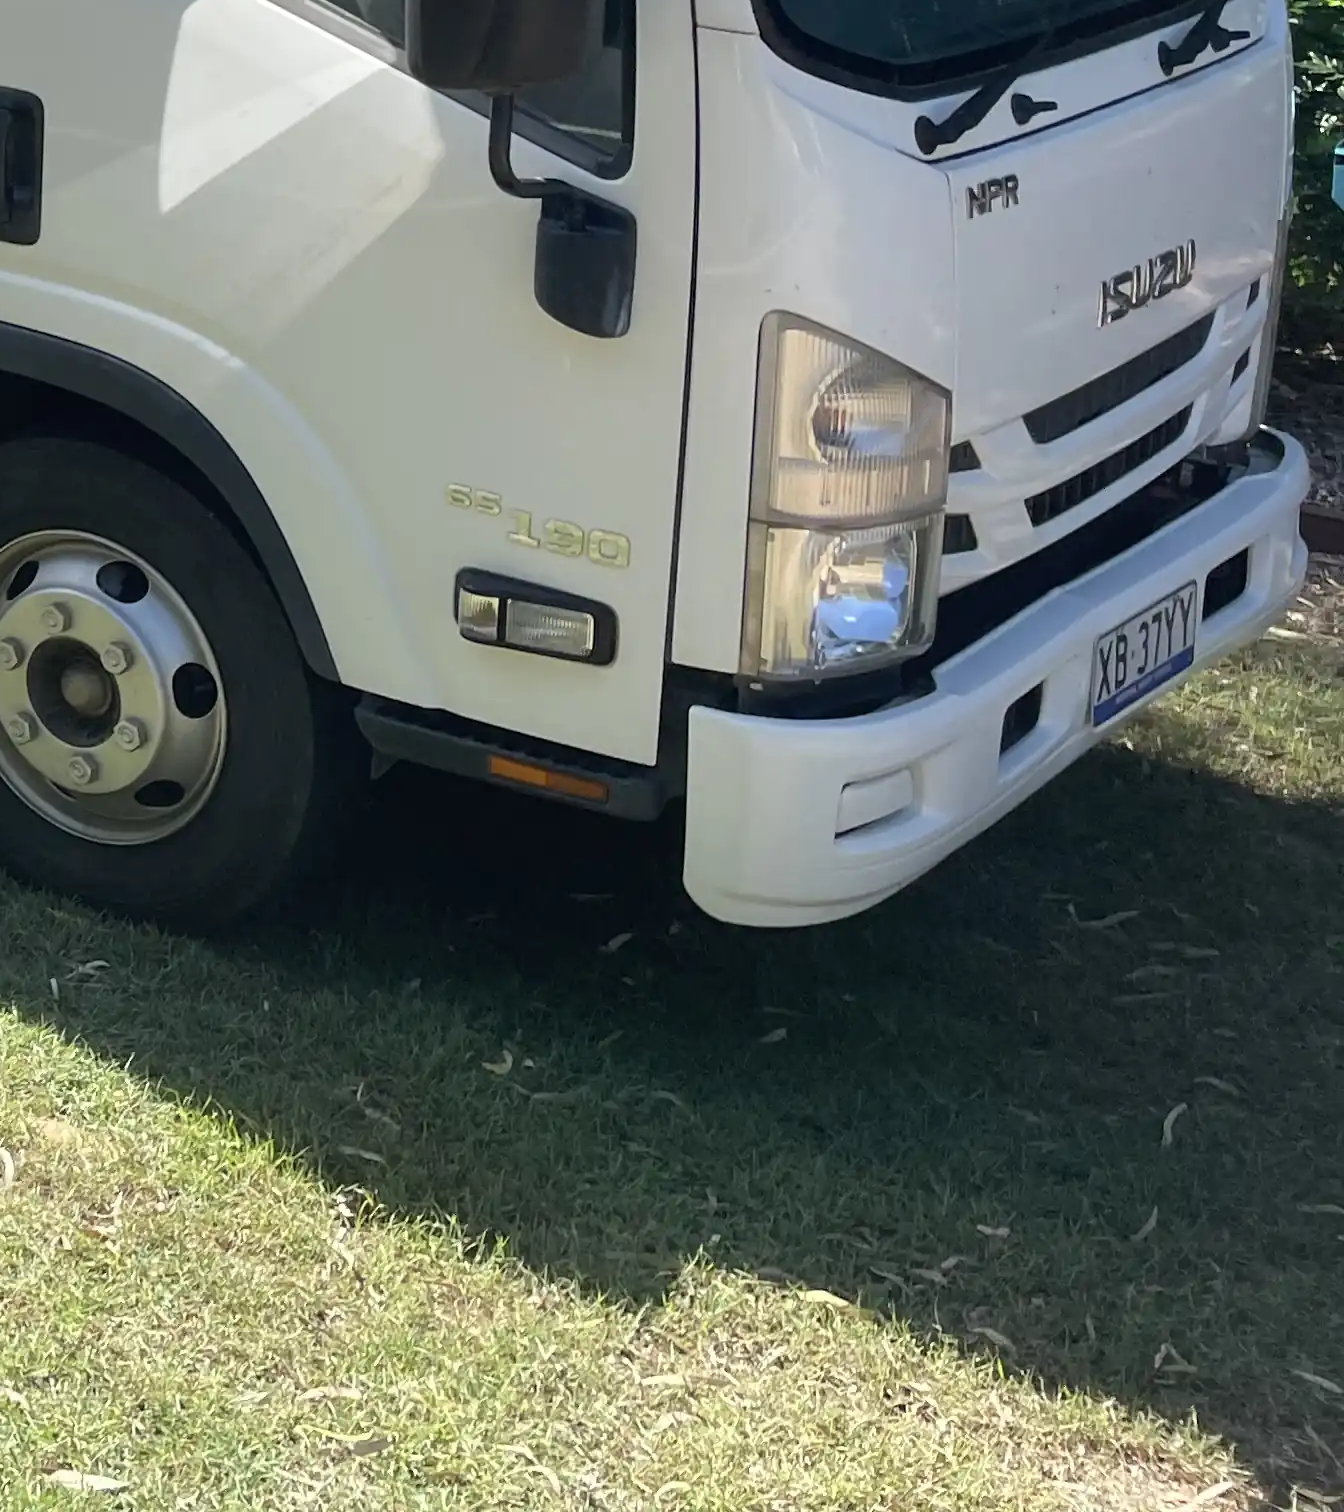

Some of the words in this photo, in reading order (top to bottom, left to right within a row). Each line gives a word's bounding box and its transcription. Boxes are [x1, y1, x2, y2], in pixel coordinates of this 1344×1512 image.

[965, 173, 1019, 219] NPR
[1097, 238, 1196, 329] ISUZU
[507, 508, 631, 569] 190
